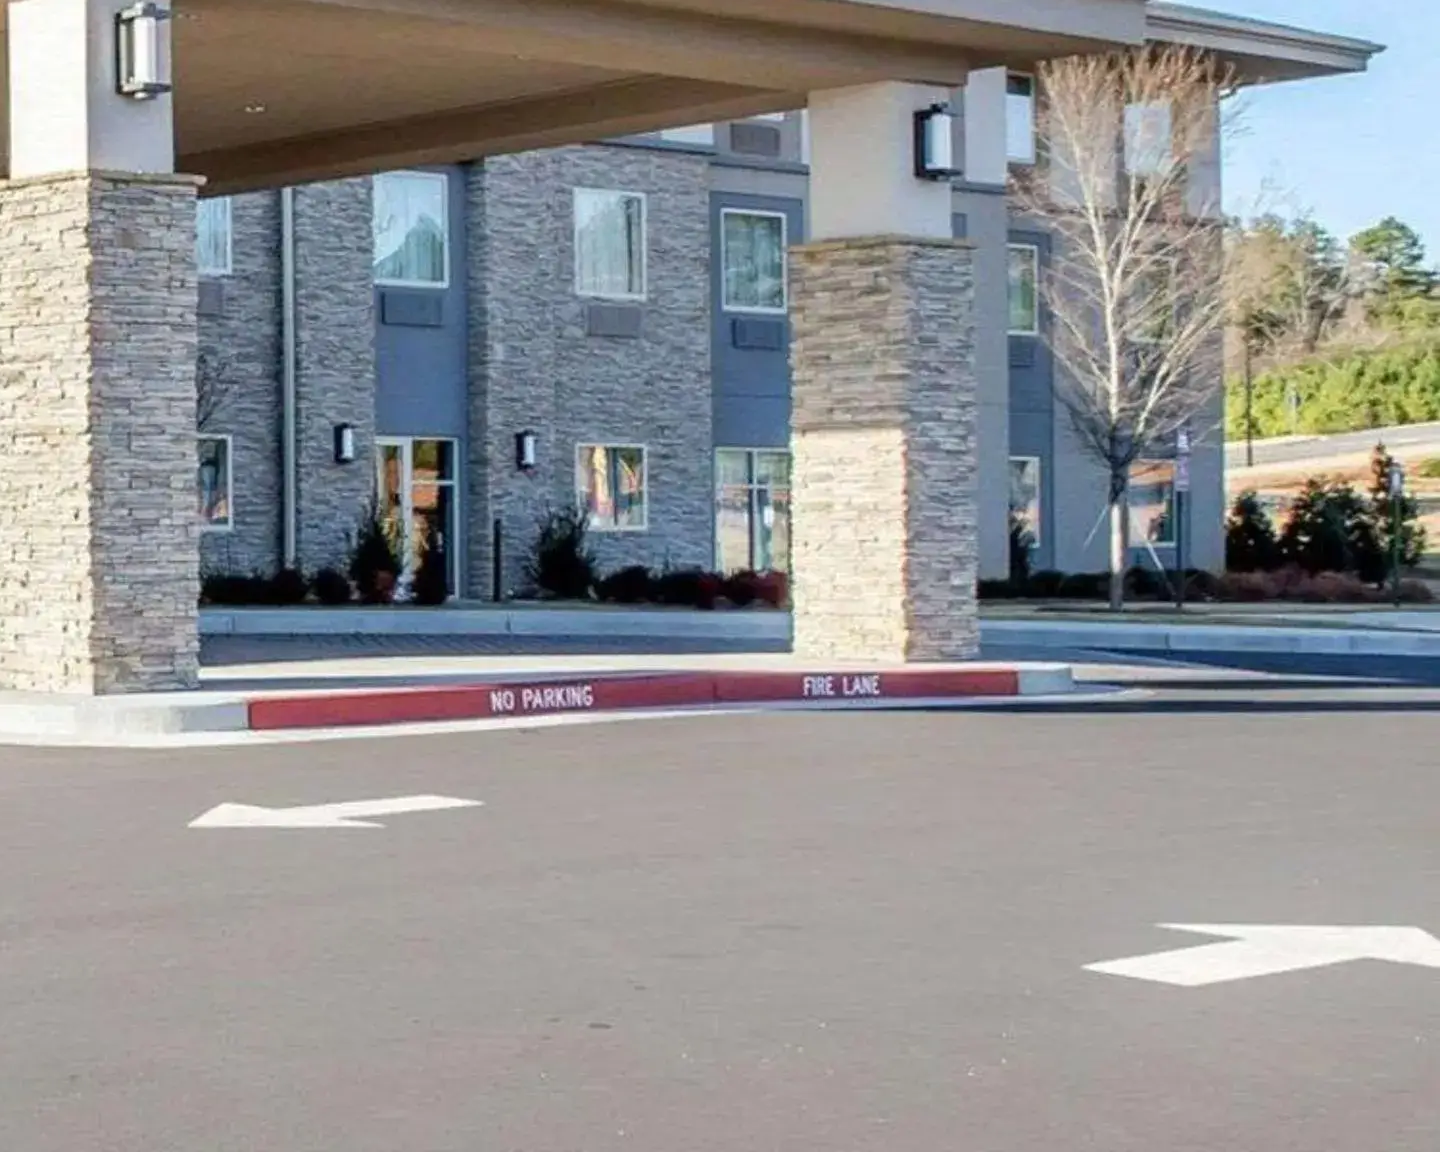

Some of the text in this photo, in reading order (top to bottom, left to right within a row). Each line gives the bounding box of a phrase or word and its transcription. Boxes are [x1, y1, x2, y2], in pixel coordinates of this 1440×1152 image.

[802, 675, 880, 696] FIRE LANE
[490, 685, 594, 711] NO PARKING
